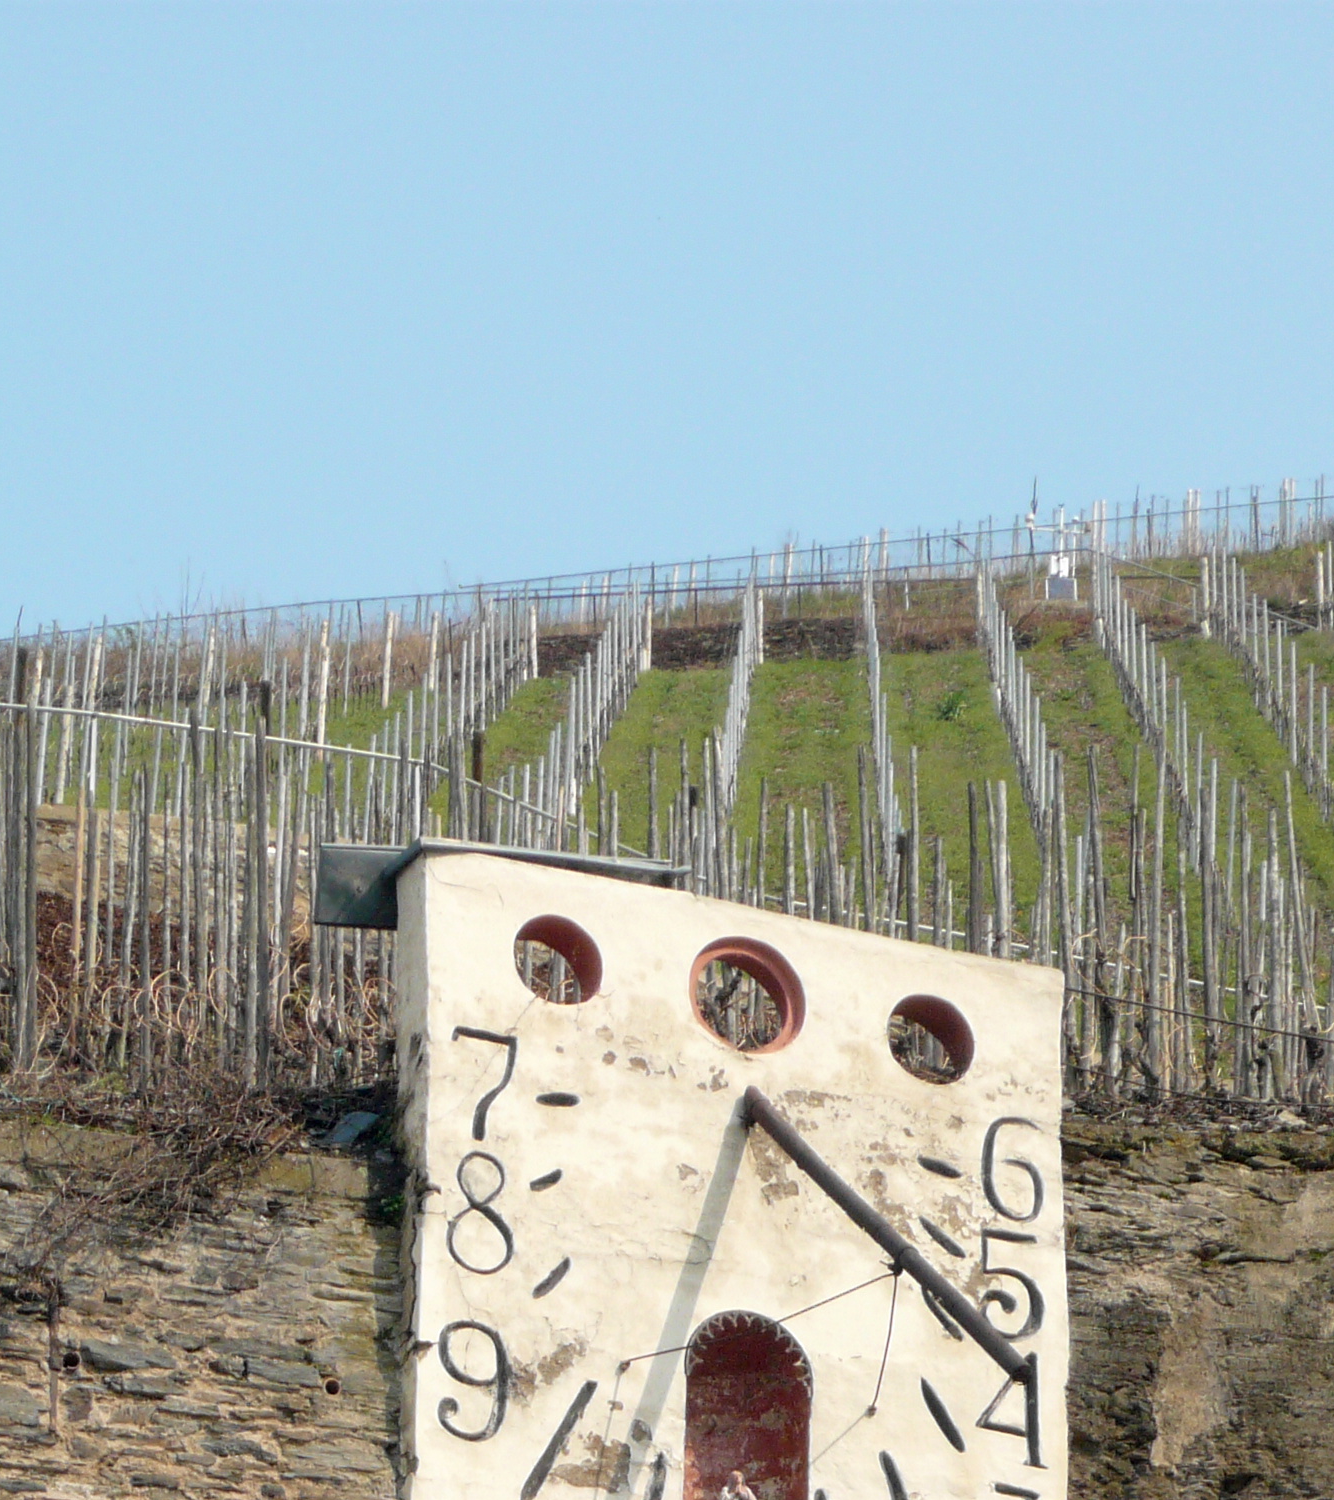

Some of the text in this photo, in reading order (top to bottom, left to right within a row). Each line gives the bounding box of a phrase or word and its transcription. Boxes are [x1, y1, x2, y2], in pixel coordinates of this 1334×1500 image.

[451, 1026, 517, 1140] 7
[447, 1151, 514, 1274] 8
[982, 1117, 1042, 1222] 6
[980, 1228, 1045, 1342] 5
[437, 1320, 512, 1442] 9
[976, 1351, 1048, 1469] 4
